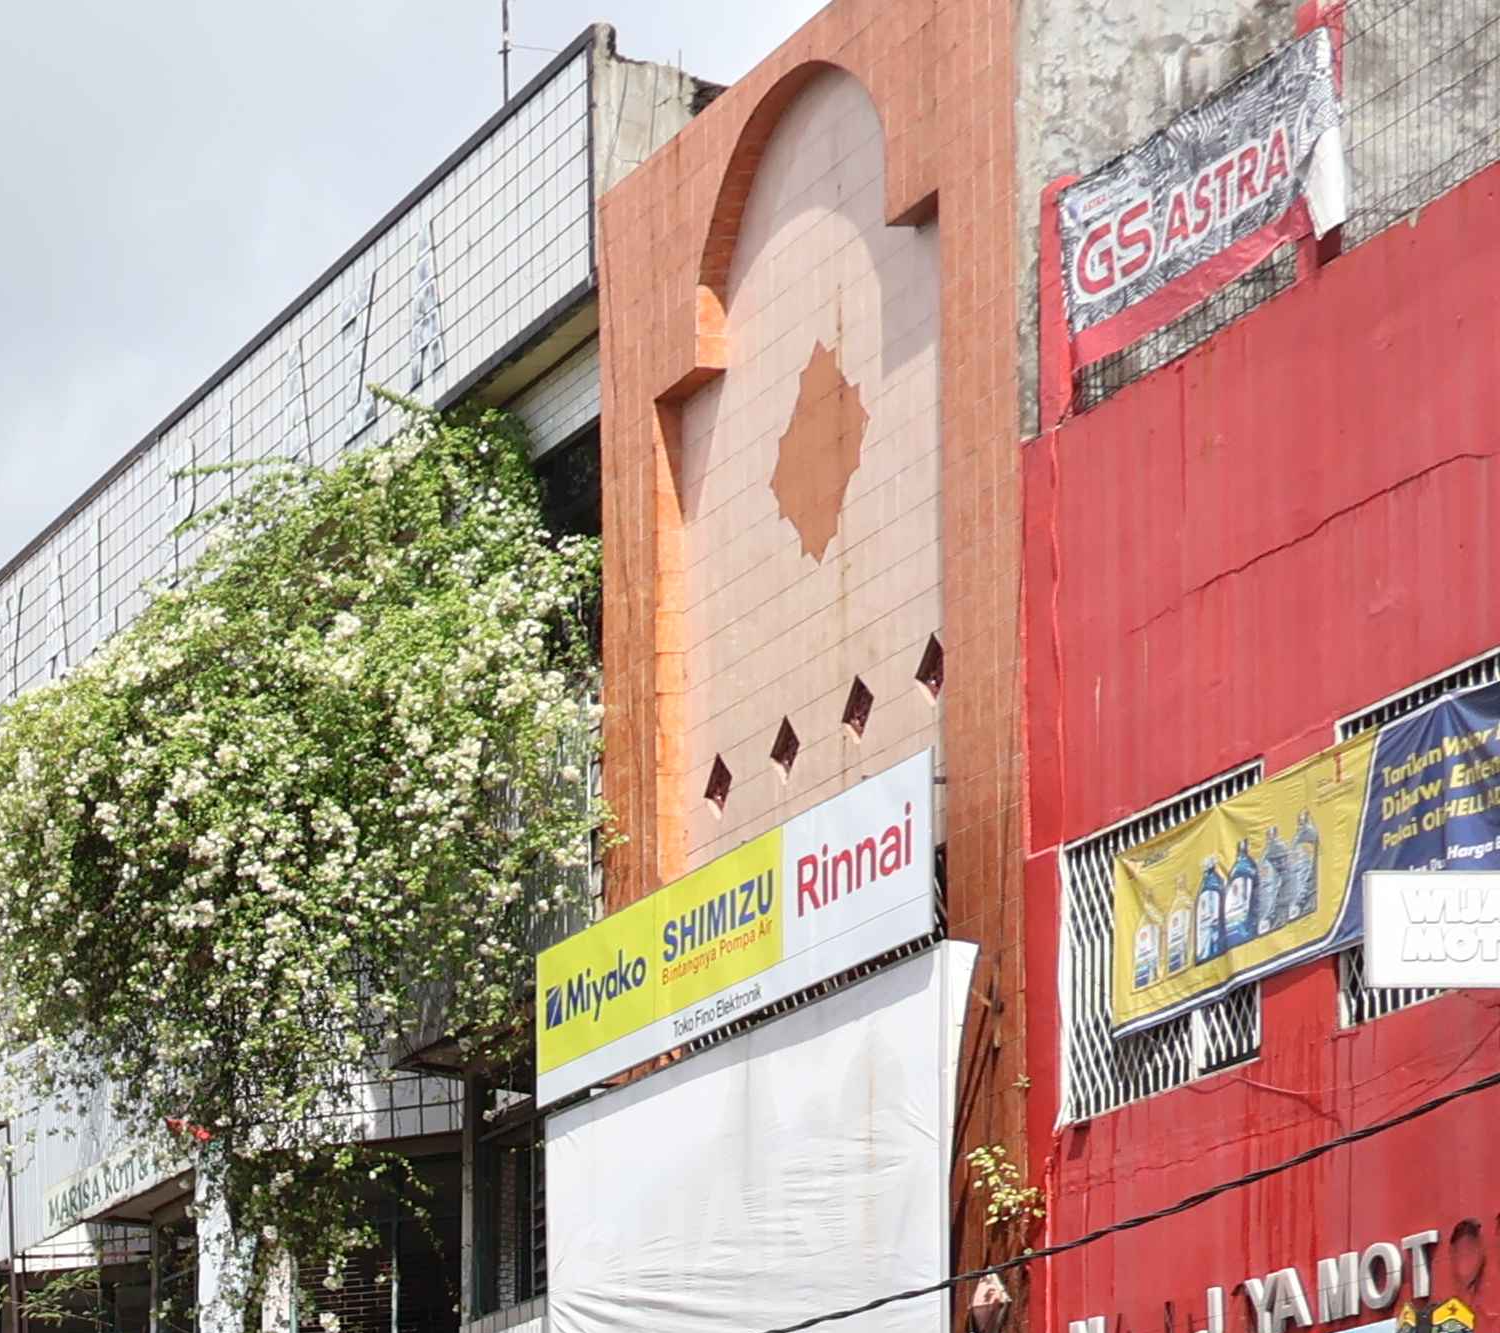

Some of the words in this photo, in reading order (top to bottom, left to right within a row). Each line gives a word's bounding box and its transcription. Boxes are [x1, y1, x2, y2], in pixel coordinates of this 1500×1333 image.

[1077, 200, 1153, 295] GS
[1162, 126, 1289, 255] ASTRA
[565, 949, 647, 1022] Miyako
[662, 868, 775, 963] SHIMIZU
[797, 801, 913, 918] Rinnai
[661, 950, 718, 986] Bintangnya
[719, 930, 757, 964] Pompa
[757, 919, 774, 942] Air
[672, 1016, 695, 1039] Toko
[694, 1007, 717, 1030] Fino
[716, 984, 763, 1020] Elektronik
